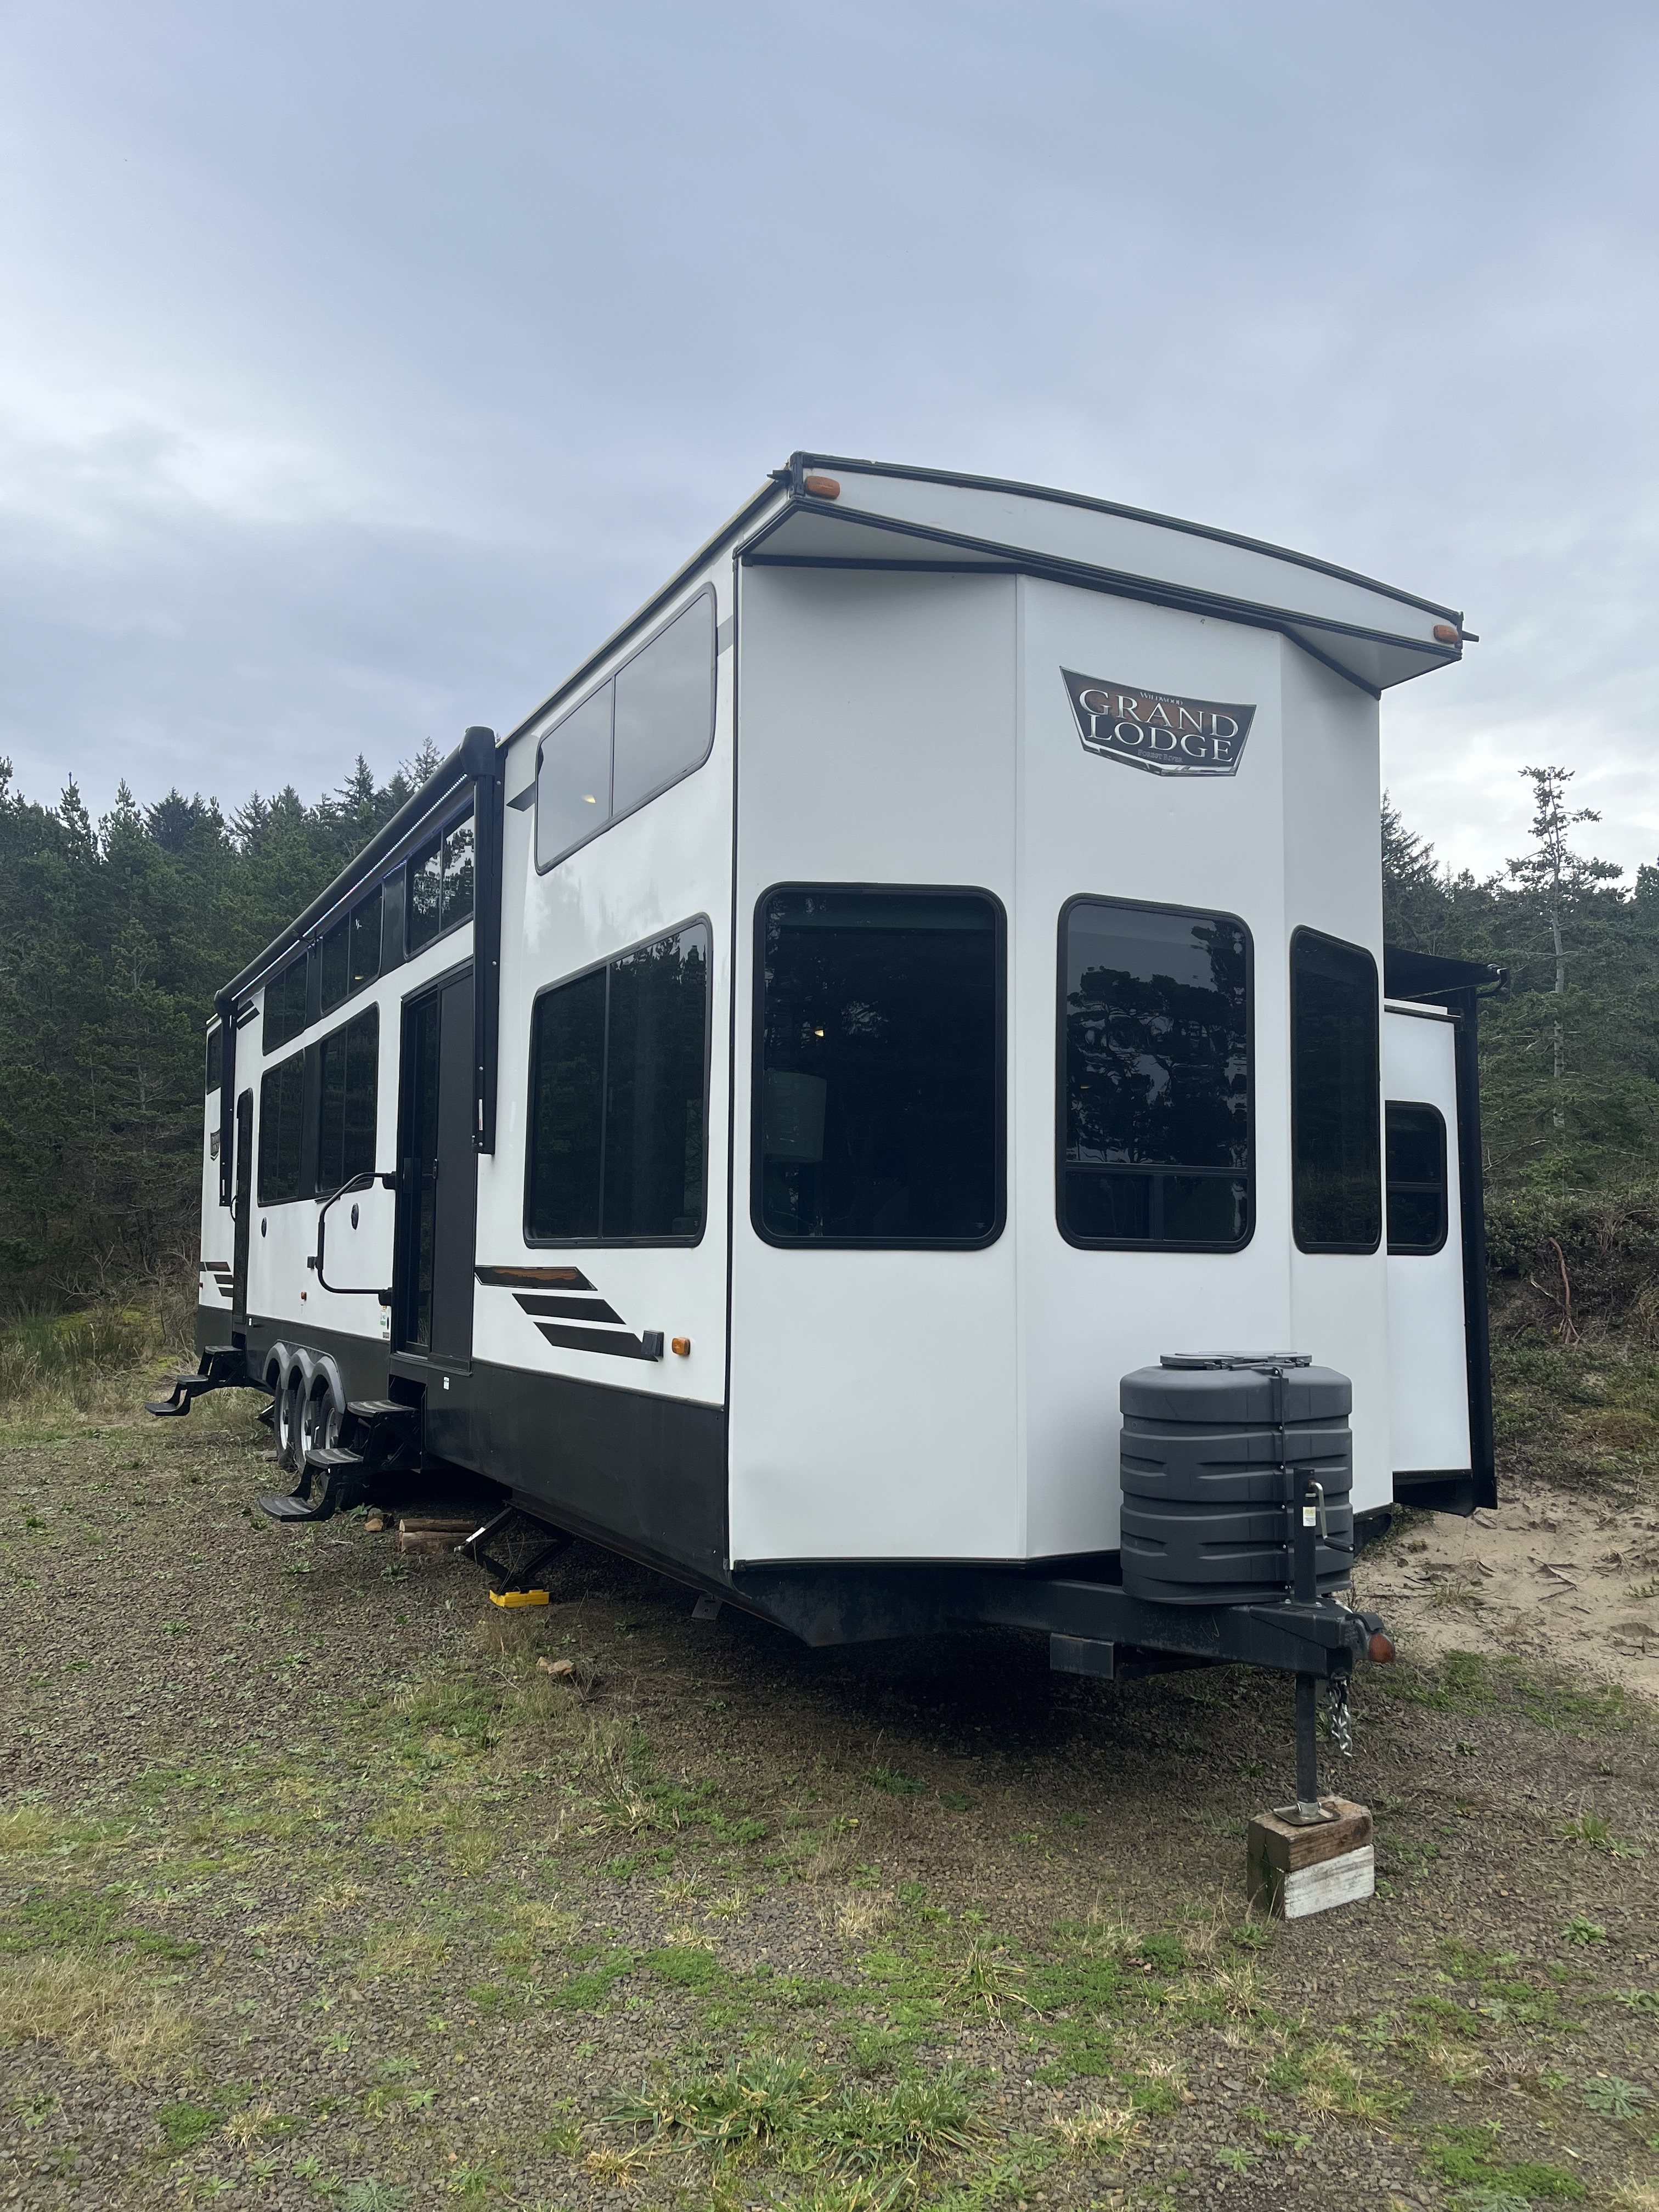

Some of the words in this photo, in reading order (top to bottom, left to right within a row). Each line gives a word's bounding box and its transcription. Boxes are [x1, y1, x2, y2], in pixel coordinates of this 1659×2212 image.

[1079, 689, 1239, 738] GRAND
[1140, 692, 1183, 706] WILDWOOD
[1087, 713, 1233, 762] LODGE
[1137, 749, 1163, 760] FOREST
